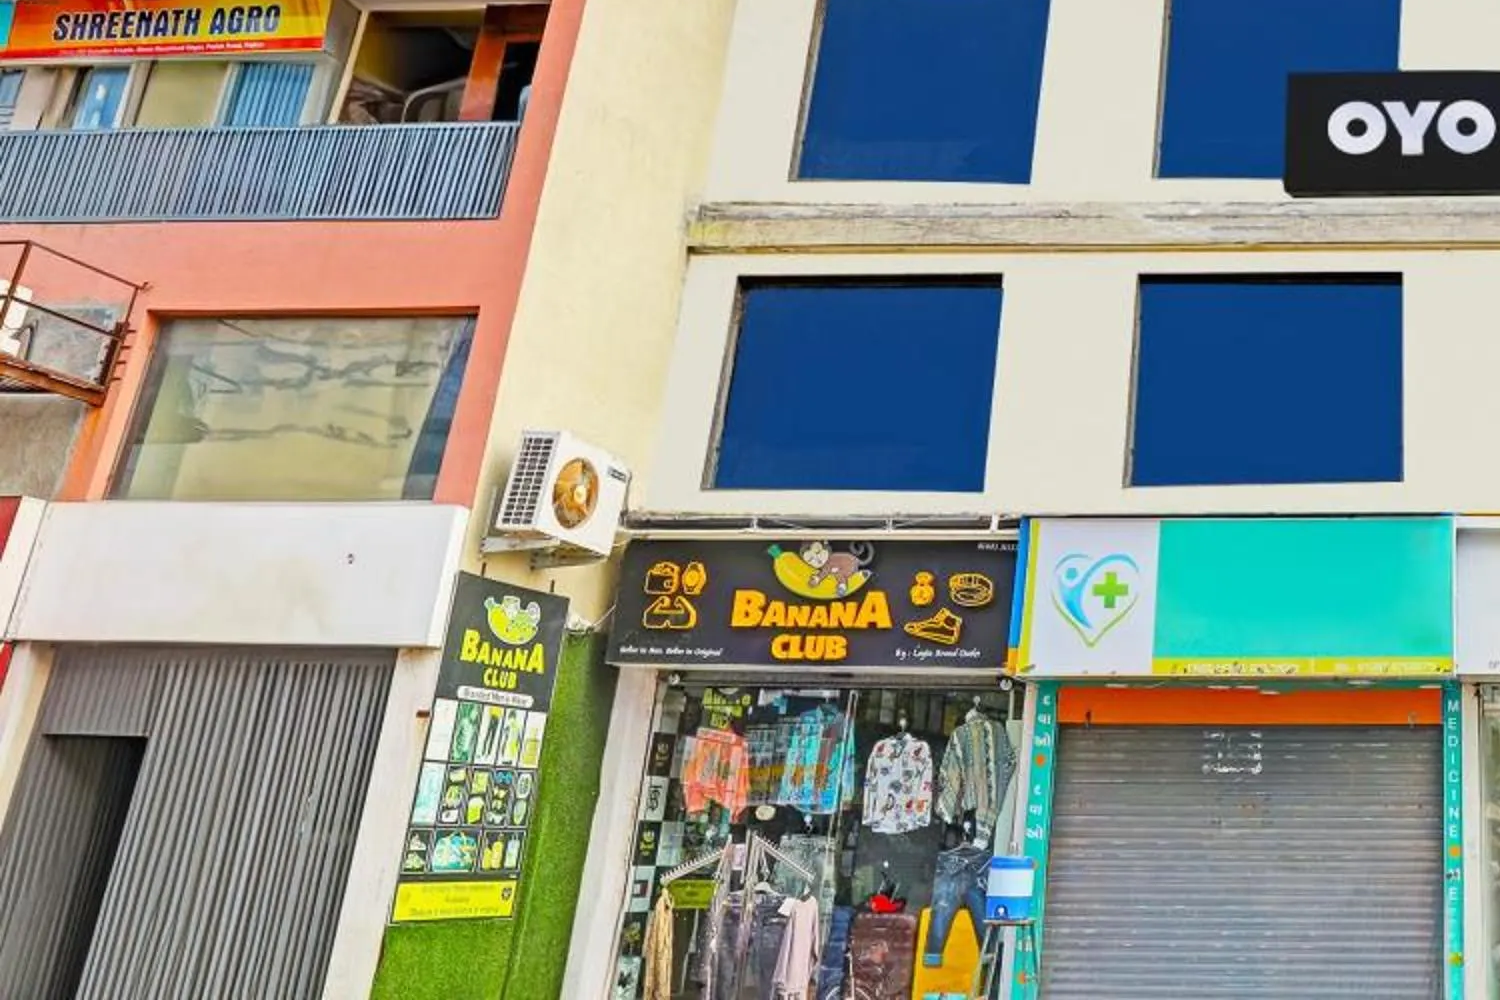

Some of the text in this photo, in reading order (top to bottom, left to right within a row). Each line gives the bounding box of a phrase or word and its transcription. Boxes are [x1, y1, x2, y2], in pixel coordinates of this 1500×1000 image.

[54, 4, 281, 41] SHREENATH AGRO
[1327, 100, 1496, 156] OYO
[731, 589, 893, 630] BANANA
[460, 629, 544, 674] BANANA
[771, 635, 848, 661] CLUB
[484, 668, 517, 689] CLUB
[1447, 700, 1460, 838] MEDICINE
